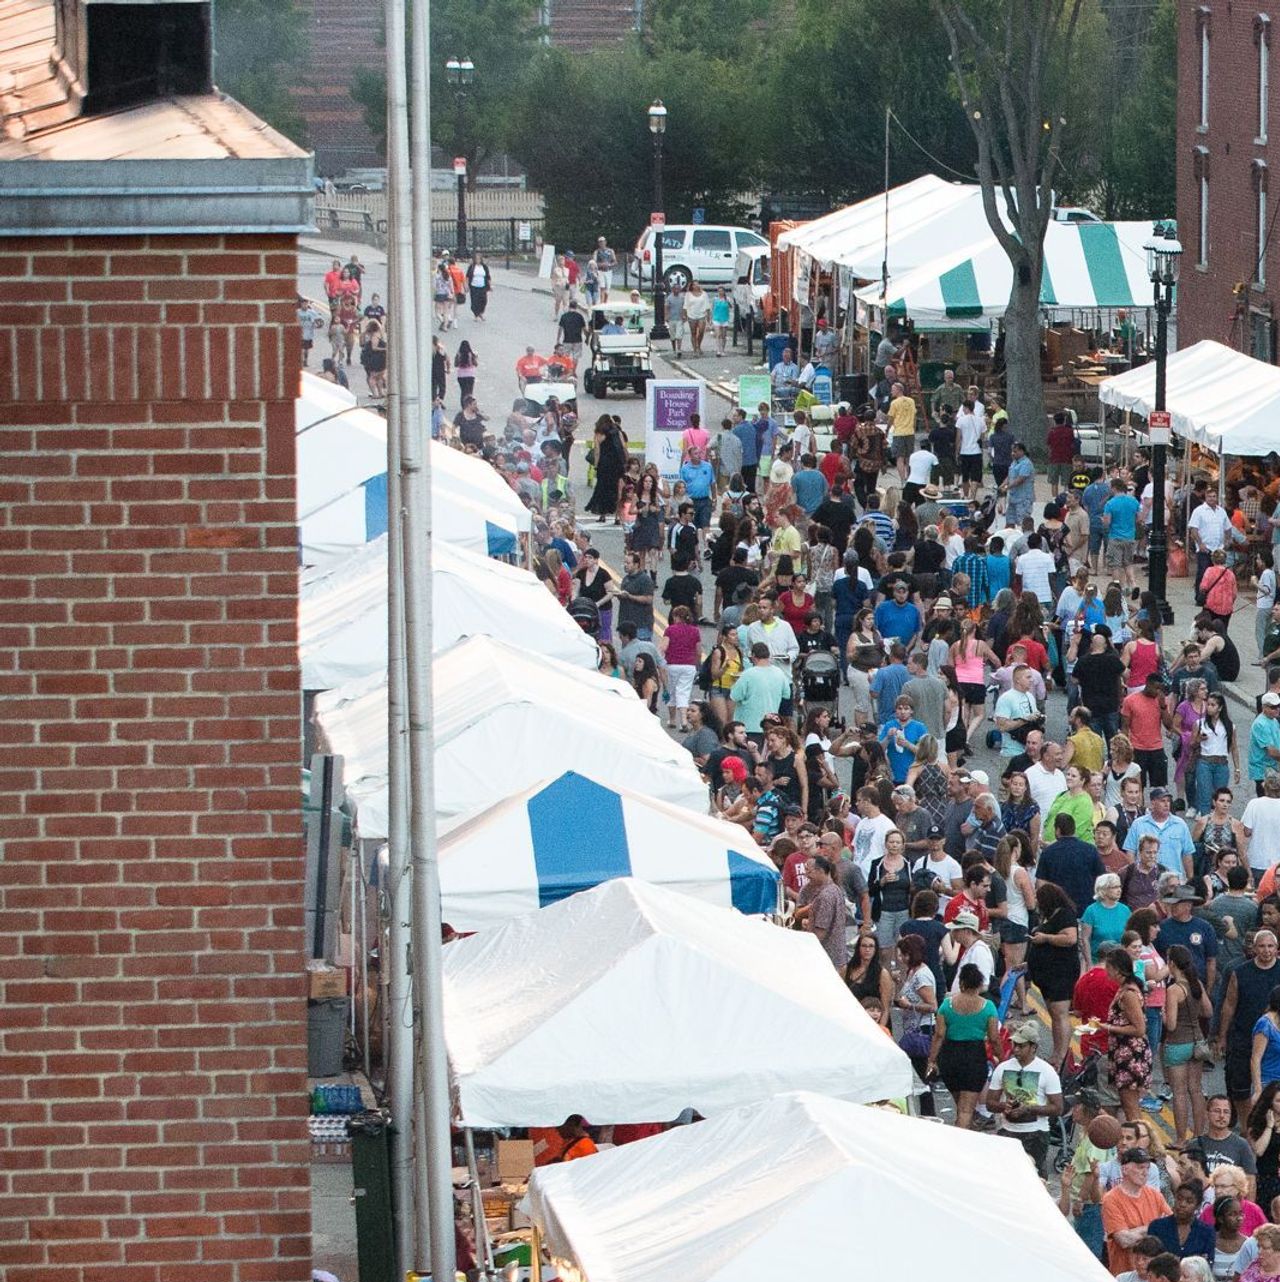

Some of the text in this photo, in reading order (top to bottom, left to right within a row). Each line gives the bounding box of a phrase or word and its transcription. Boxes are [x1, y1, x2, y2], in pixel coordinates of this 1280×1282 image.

[660, 390, 695, 400] Boarding
[664, 400, 690, 408] House
[668, 408, 685, 416] Park
[666, 419, 687, 427] Stage
